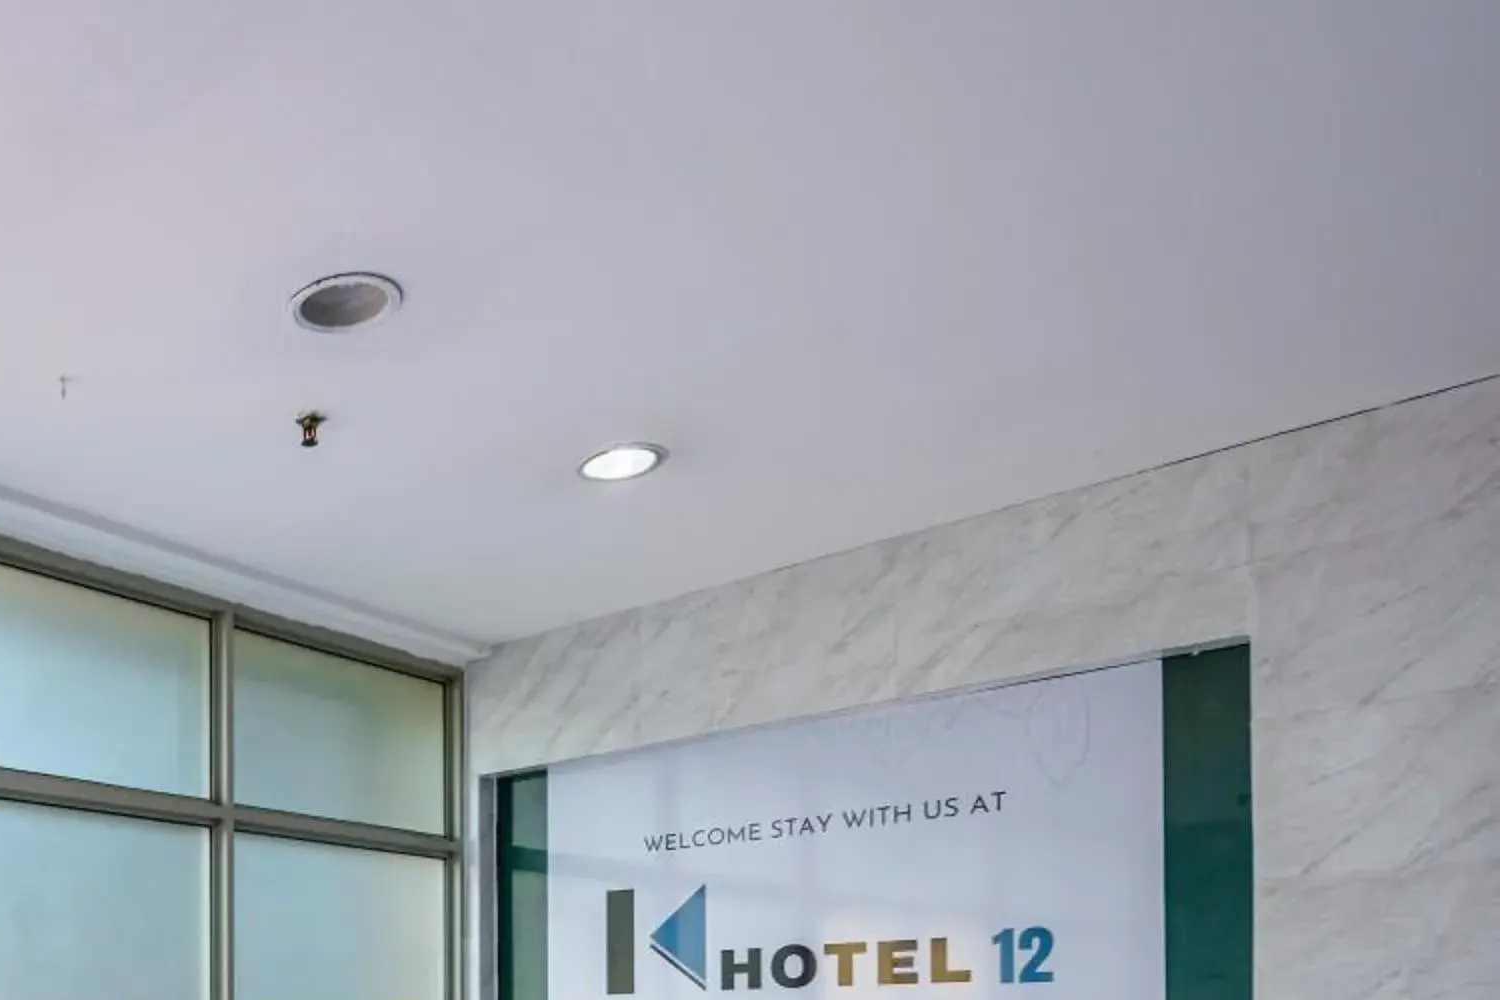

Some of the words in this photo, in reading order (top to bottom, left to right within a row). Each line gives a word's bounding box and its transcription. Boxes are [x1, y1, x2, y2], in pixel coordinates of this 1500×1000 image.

[644, 822, 763, 853] WELCOME
[770, 812, 834, 839] STAY
[842, 803, 912, 830] WITH
[922, 796, 960, 820] US
[968, 790, 1008, 815] AT
[720, 937, 973, 991] HOTEL
[991, 926, 1056, 984] 12
